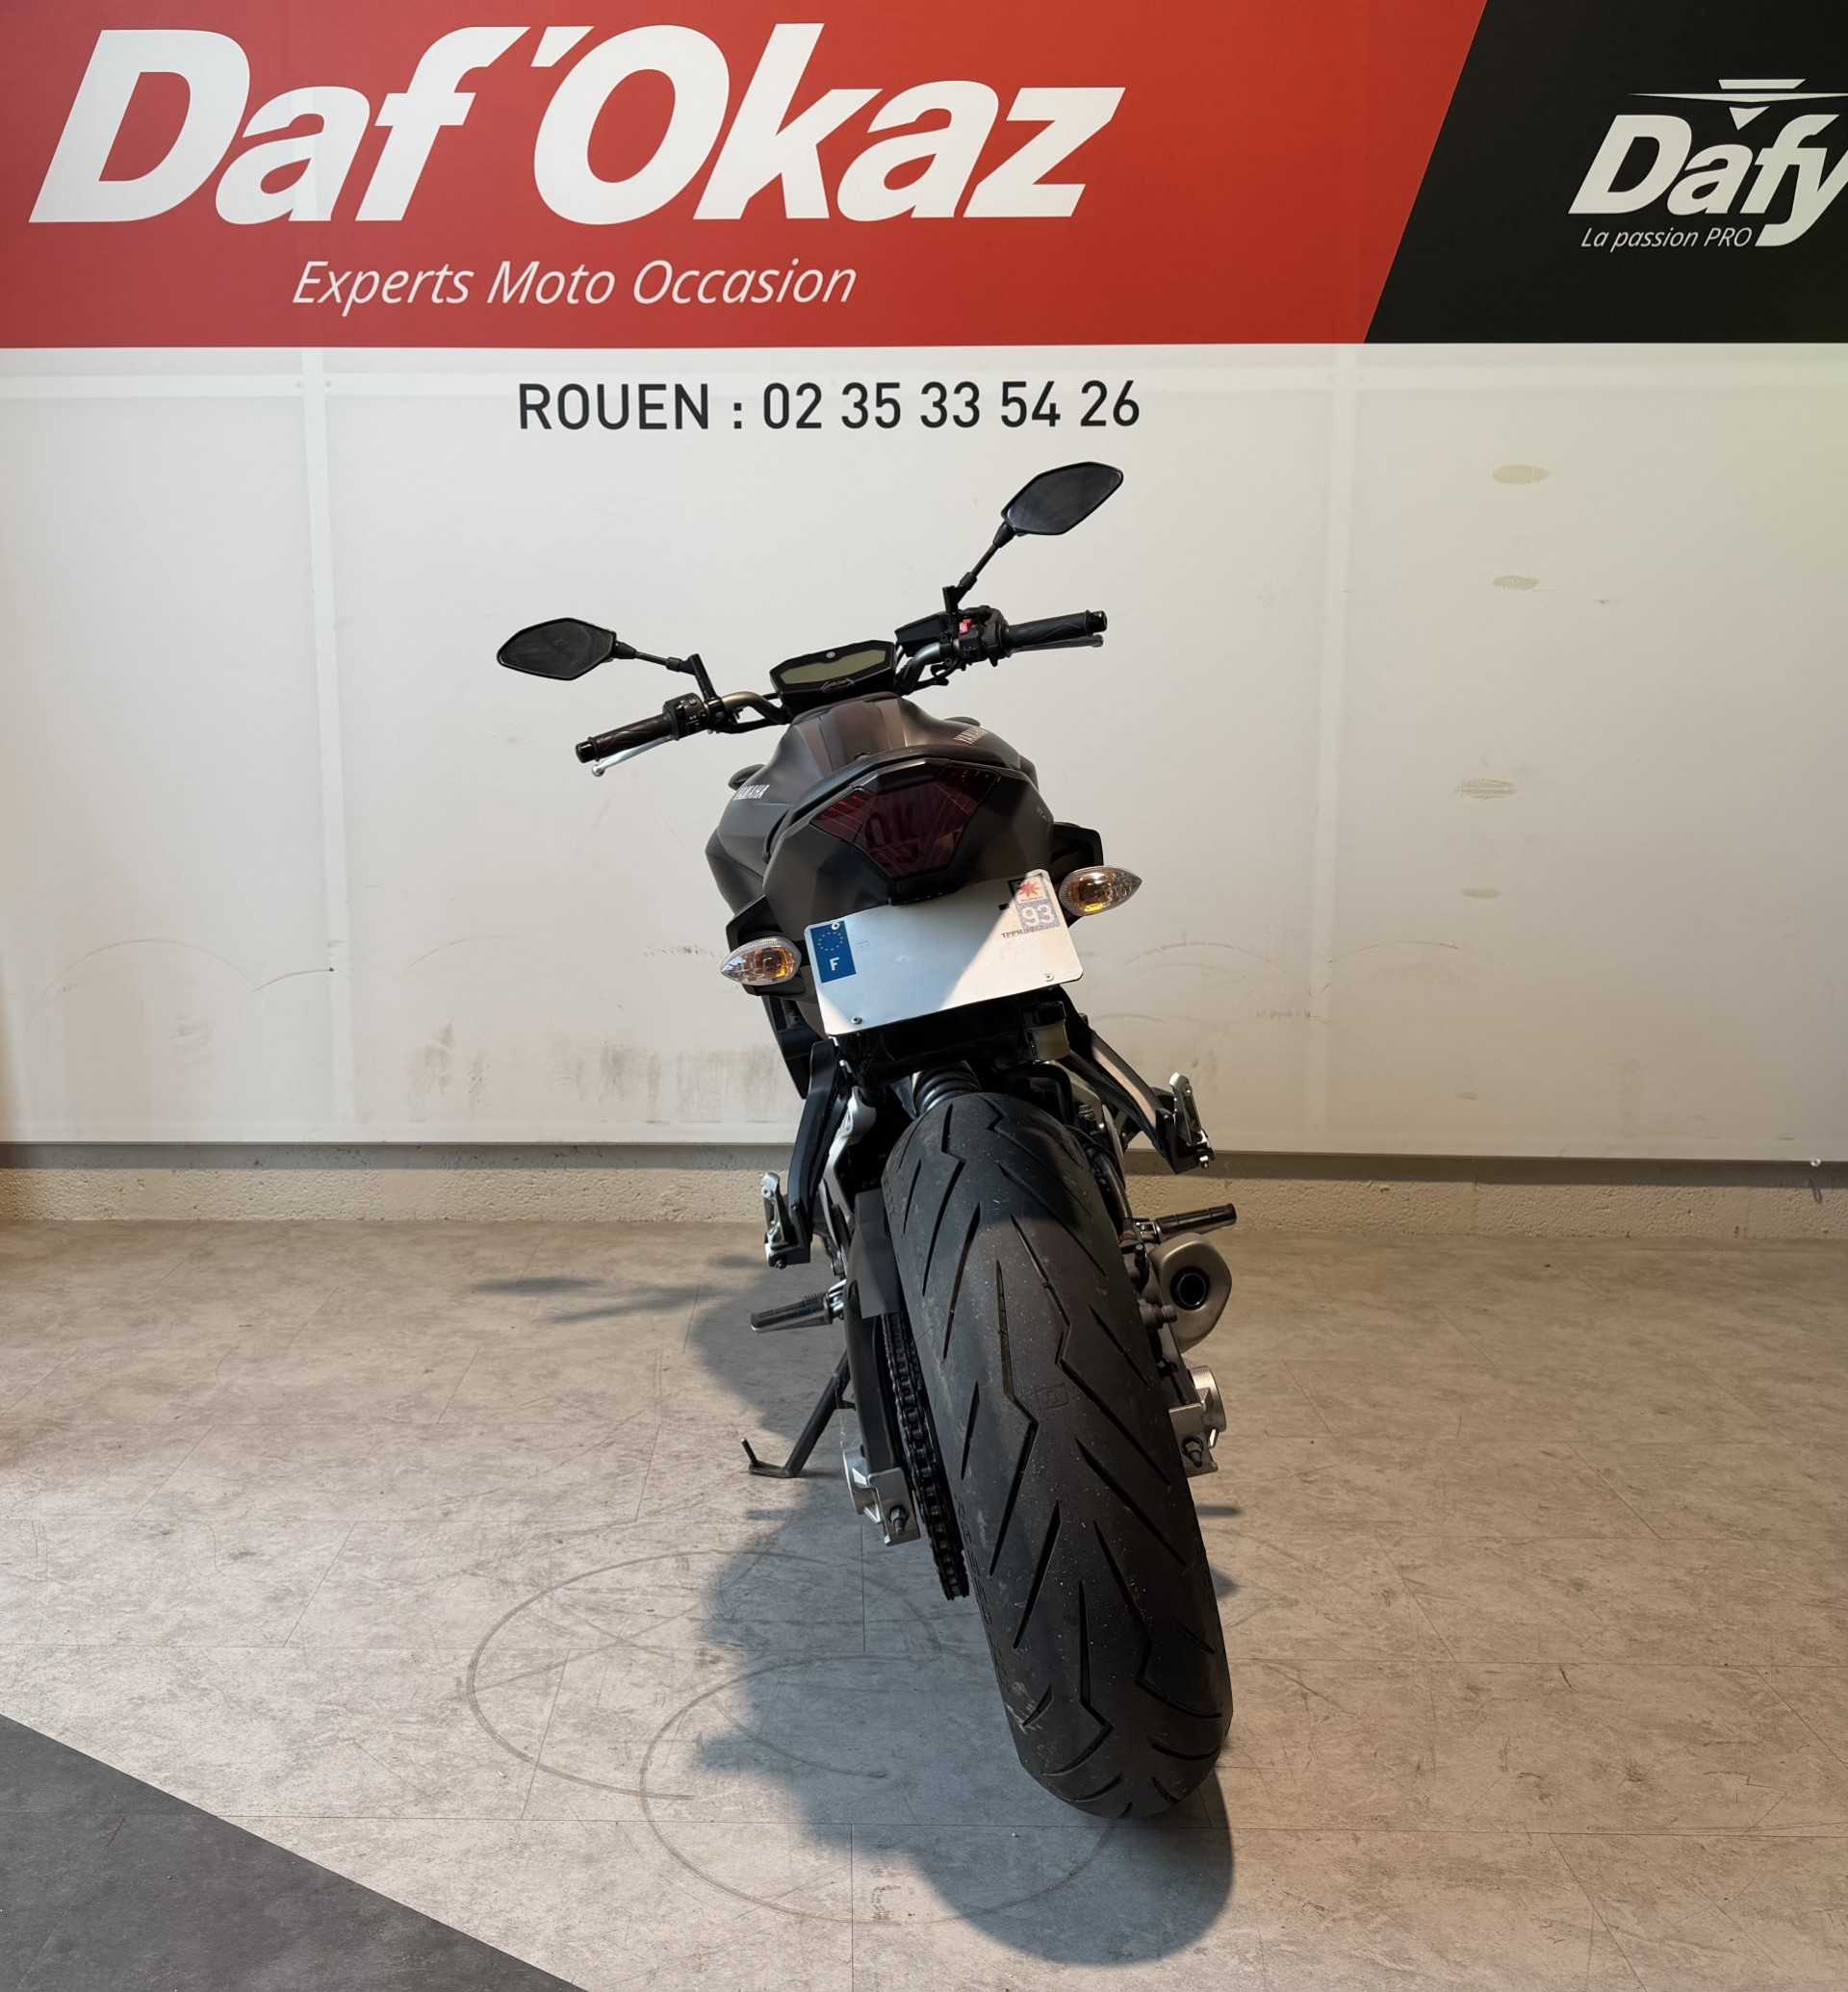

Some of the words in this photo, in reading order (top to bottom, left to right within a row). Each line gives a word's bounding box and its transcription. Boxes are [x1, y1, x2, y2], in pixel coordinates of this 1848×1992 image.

[1569, 114, 1848, 247] Dafy
[1580, 227, 1609, 247] La
[1610, 227, 1699, 253] passion
[1704, 227, 1753, 247] PRO
[292, 260, 475, 318] Experts
[486, 260, 616, 305] Moto
[633, 258, 857, 305] Occasion
[519, 383, 708, 430] ROUEN
[763, 382, 822, 430] 02
[841, 381, 901, 429] 35
[920, 380, 980, 429] 33
[1000, 380, 1062, 428] 54
[1080, 379, 1140, 427] 26
[1021, 904, 1056, 926] 93
[829, 957, 840, 971] F
